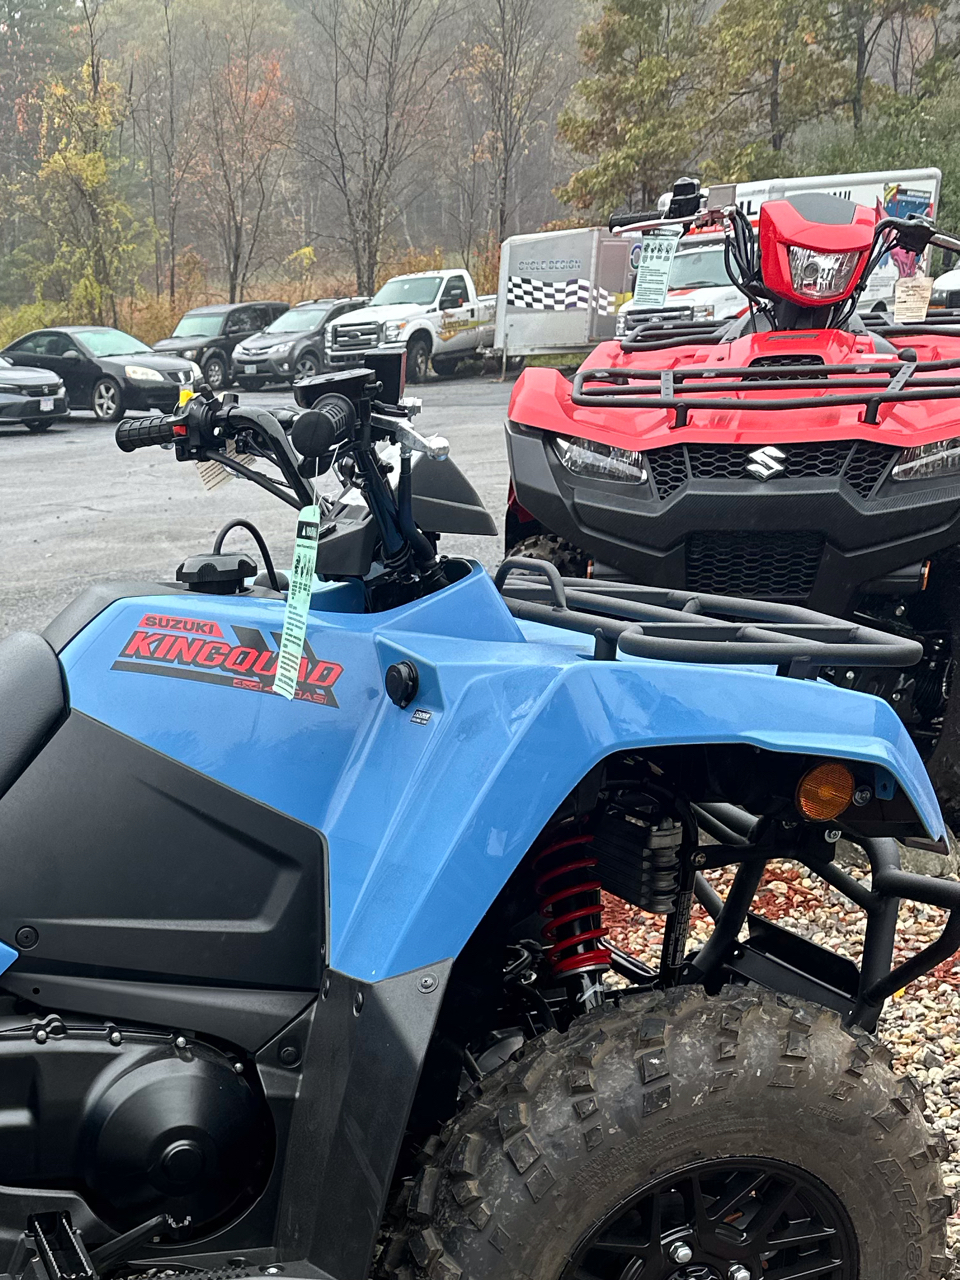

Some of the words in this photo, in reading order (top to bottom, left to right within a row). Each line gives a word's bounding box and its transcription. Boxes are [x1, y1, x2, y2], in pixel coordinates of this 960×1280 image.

[518, 261, 546, 270] CYCLE
[549, 259, 581, 270] DESIGN
[145, 615, 214, 634] SUZUKI
